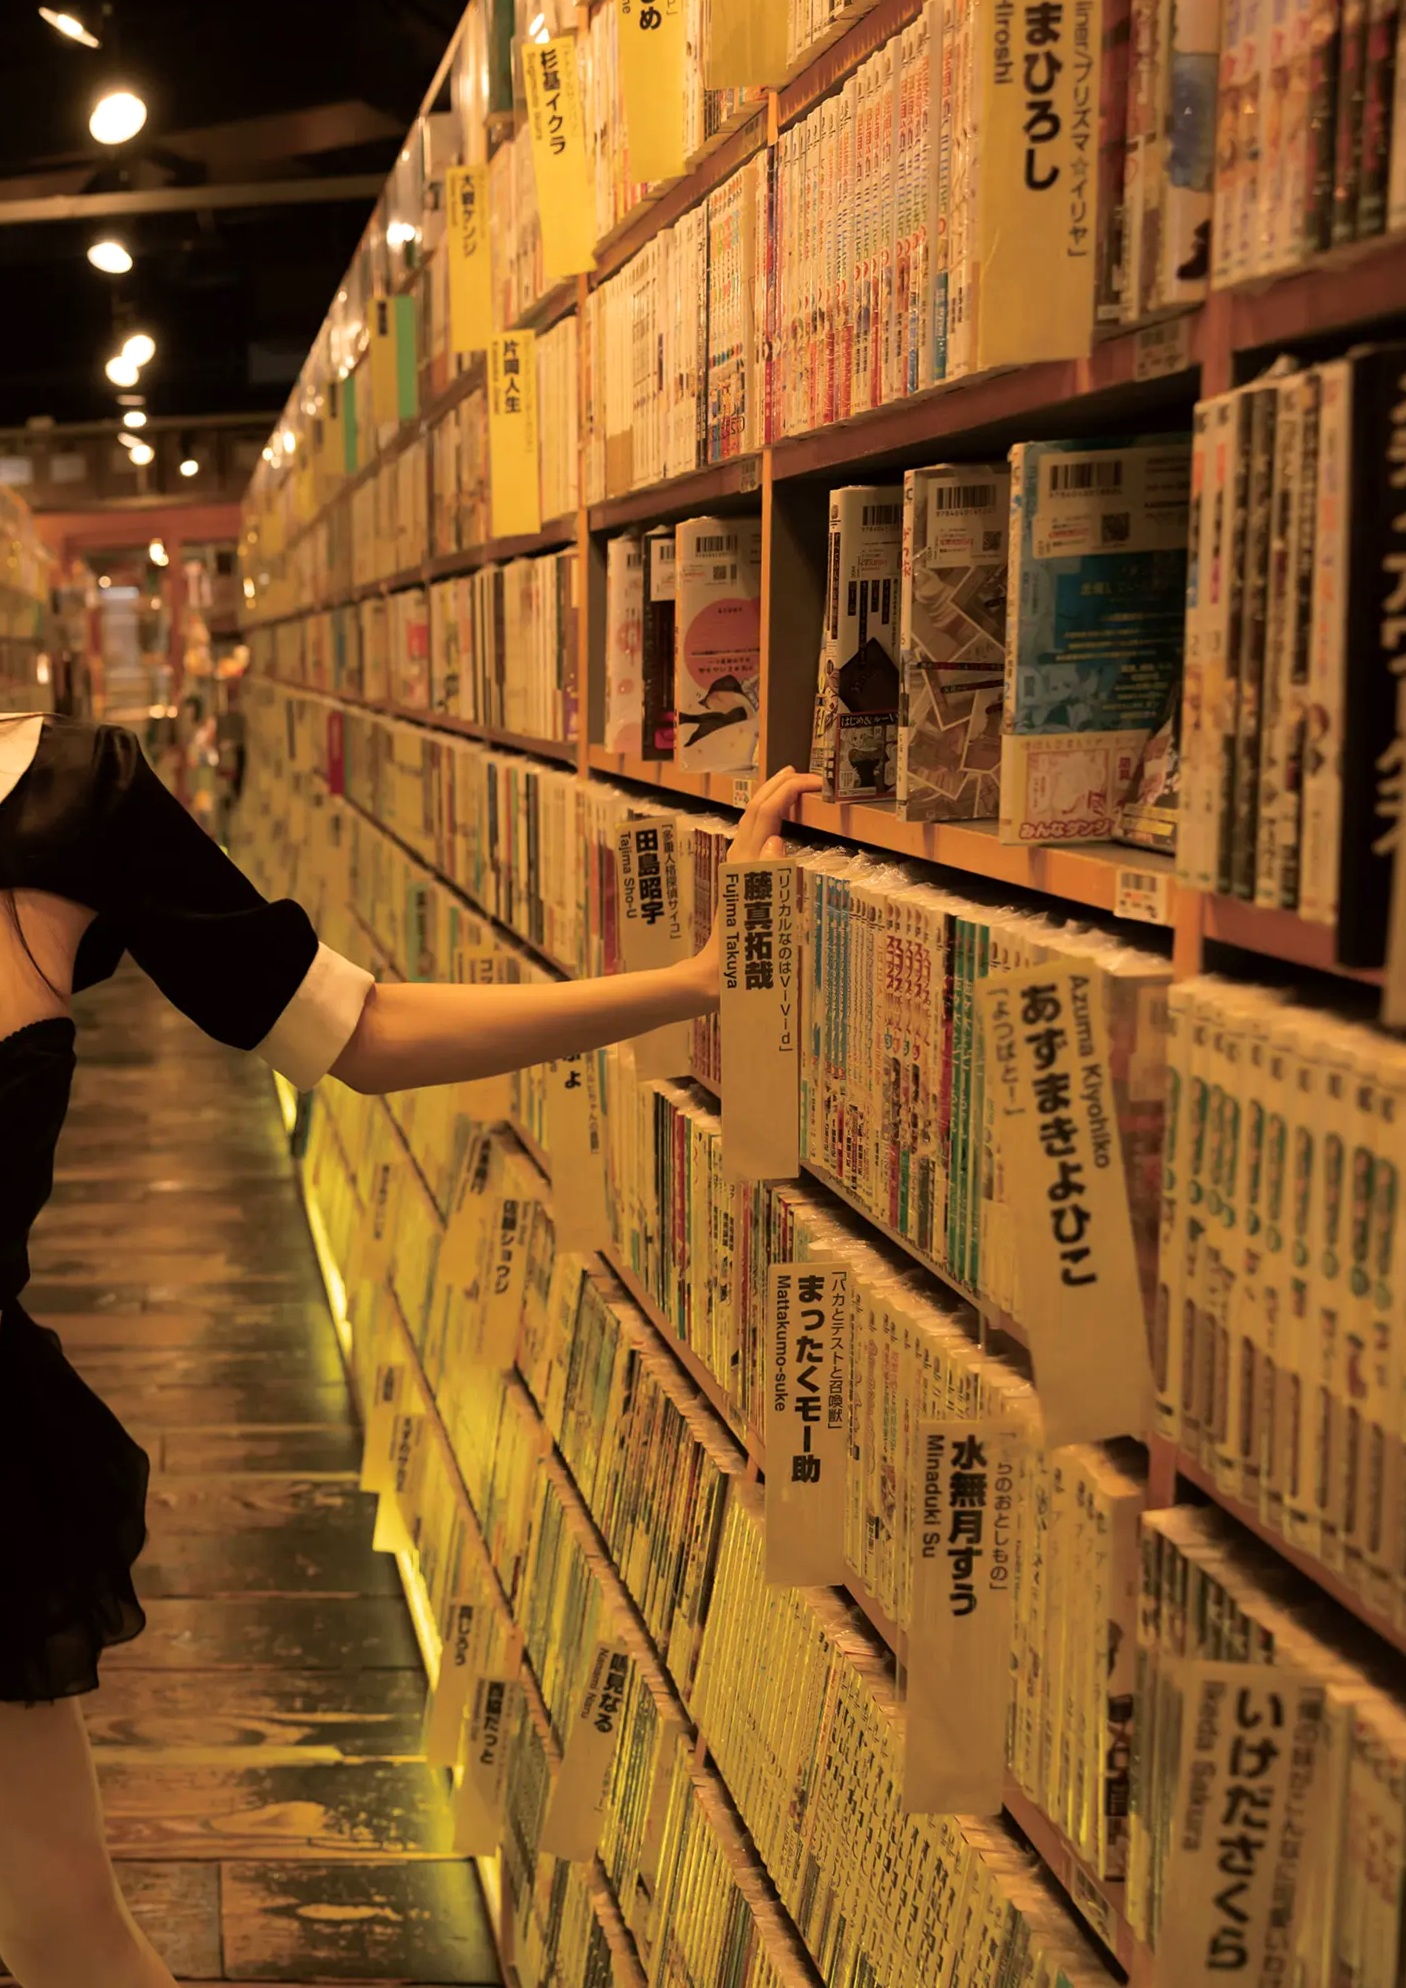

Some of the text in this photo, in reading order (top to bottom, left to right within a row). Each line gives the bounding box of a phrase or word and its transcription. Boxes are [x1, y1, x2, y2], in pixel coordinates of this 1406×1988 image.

[639, 0, 662, 30] め
[1023, 1, 1063, 191] まひろし
[619, 831, 637, 918] Tajima Sho-U
[636, 829, 665, 925] 田島昭宇
[723, 873, 740, 989] Fujima Takuya
[744, 871, 774, 990] 藤真拓哉
[1020, 983, 1098, 1288] あずまきよひこ
[1069, 975, 1111, 1169] Azuma Kiyohiko
[774, 1275, 791, 1412] Mattakumo-suke
[791, 1274, 825, 1483] まったくモー助
[828, 1271, 847, 1429] 「バカとテストと召喚獣」
[922, 1434, 945, 1558] Minaduki Su
[947, 1434, 988, 1617] 水無月すう
[1205, 1686, 1284, 1971] いけださくら
